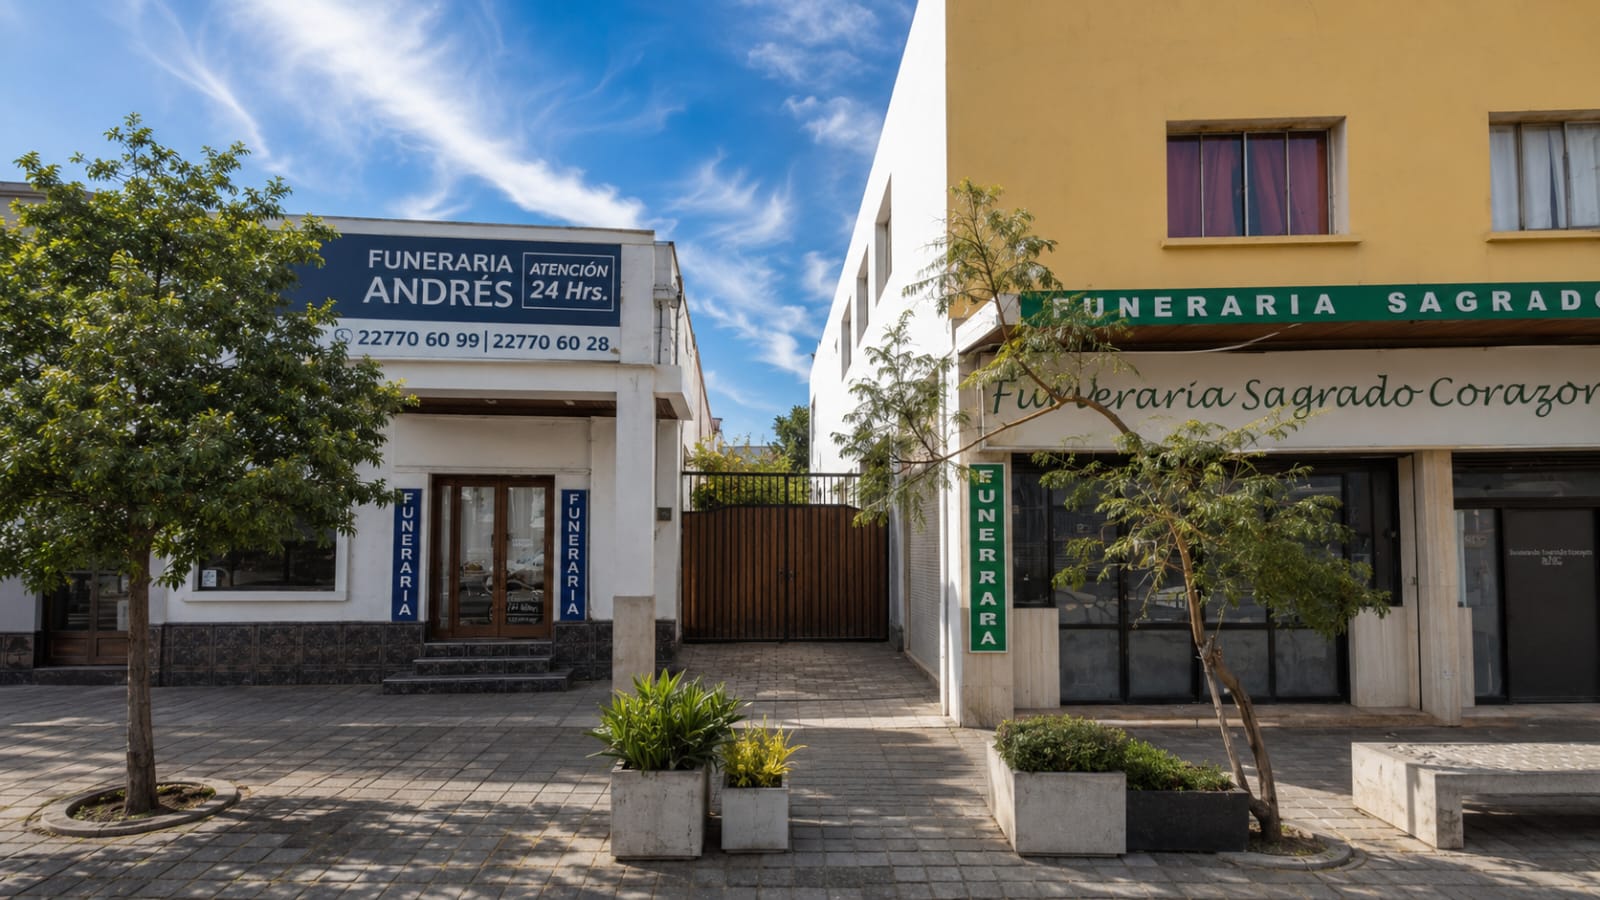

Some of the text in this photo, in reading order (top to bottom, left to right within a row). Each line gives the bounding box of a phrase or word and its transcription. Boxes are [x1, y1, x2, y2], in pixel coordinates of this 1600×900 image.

[368, 249, 513, 273] FUNERARIA
[529, 261, 609, 278] ATENCIÓN
[362, 275, 513, 308] ANDRÉS
[530, 280, 608, 301] 24 Hrs.
[1053, 289, 1600, 319] FUNERARIA SAGRAD
[358, 329, 610, 352] 22770 60 99 22770 60 28
[1242, 374, 1423, 420] Sagrado
[398, 491, 414, 616] FUNERARIA
[567, 493, 580, 615] FUNERARIA
